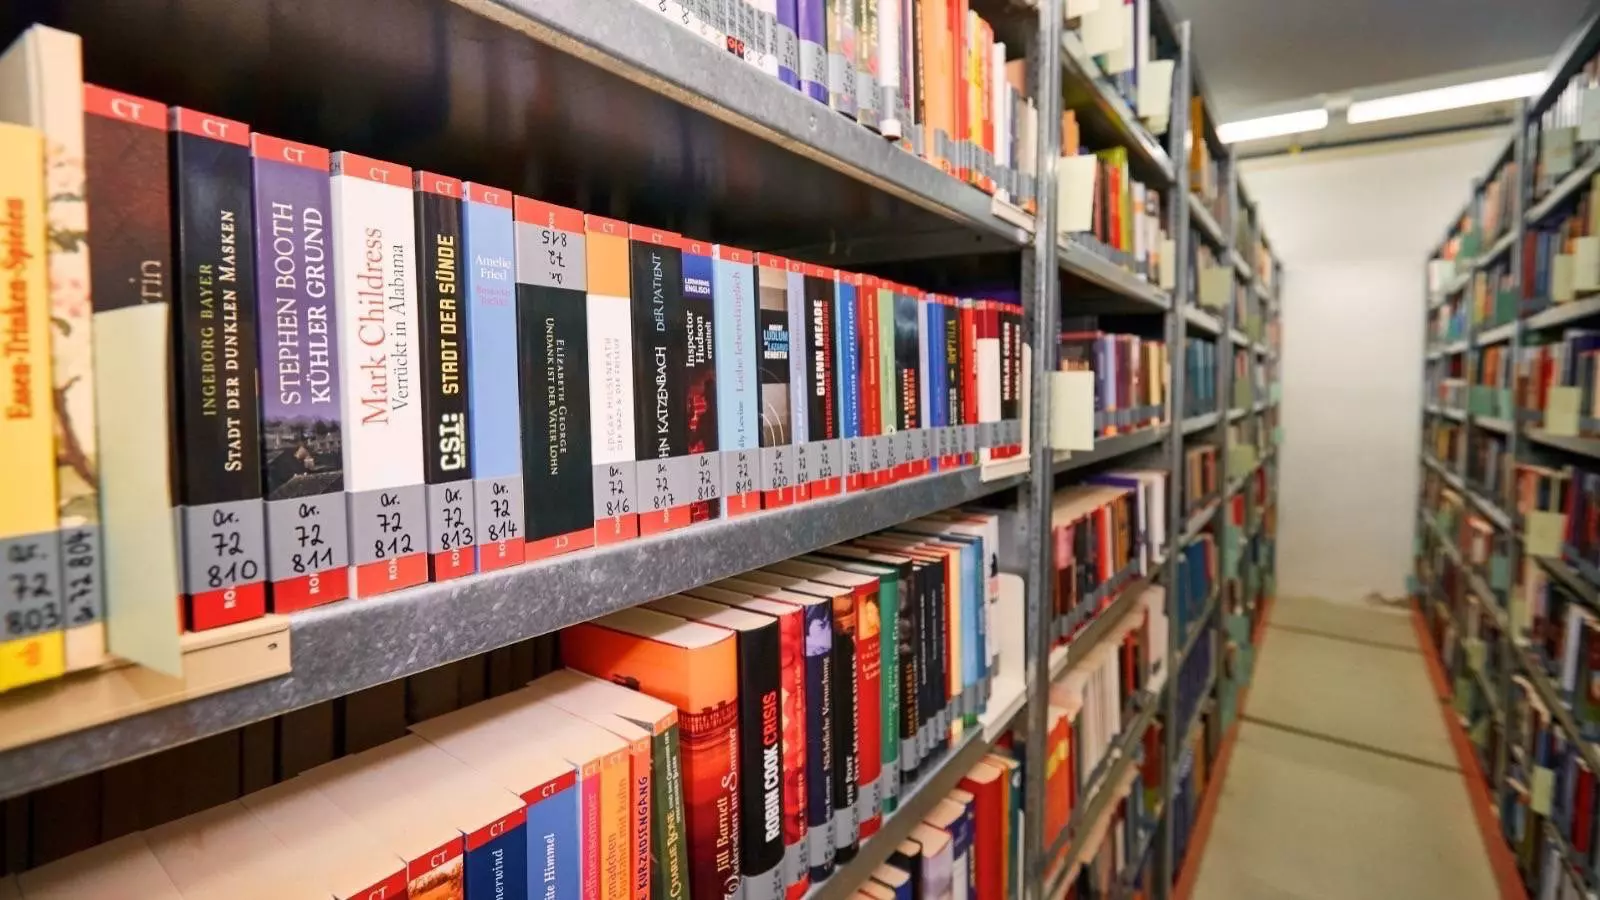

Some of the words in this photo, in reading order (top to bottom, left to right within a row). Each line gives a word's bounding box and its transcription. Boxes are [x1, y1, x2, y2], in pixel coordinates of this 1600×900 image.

[111, 98, 144, 121] CT
[202, 118, 229, 138] CT
[283, 146, 306, 163] CT
[369, 167, 390, 184] CT
[435, 181, 453, 195] CT
[484, 191, 500, 205] CT
[541, 230, 567, 248] 815
[602, 222, 615, 233] CT
[218, 209, 236, 282] MASKEN
[272, 202, 296, 290] BOOTH
[303, 207, 325, 299] GRUND
[547, 249, 567, 268] 72
[435, 234, 456, 294] SÜNDE
[652, 252, 665, 303] PATIENT
[199, 264, 213, 319] BAYER
[356, 227, 387, 346] Childress
[388, 245, 406, 317] Alabama
[222, 289, 240, 370] DUNKLEN
[391, 321, 407, 338] in
[439, 297, 458, 335] DER
[653, 304, 666, 332] DER
[813, 299, 824, 347] MEADE
[277, 298, 302, 404] STEPHEN
[545, 317, 555, 364] UNDANK
[686, 310, 695, 367] Inspector
[694, 316, 705, 363] Hudson
[307, 305, 331, 403] KÜHLER
[440, 340, 459, 394] STADT
[201, 326, 217, 416] INGEBORG
[390, 341, 409, 411] Verrückt
[547, 366, 555, 382] IST
[815, 350, 826, 397] GLENN
[225, 377, 240, 410] DER
[359, 353, 389, 426] Mark
[548, 385, 556, 407] DER
[654, 346, 669, 434] KATZENBACH
[224, 417, 242, 472] STADT
[439, 413, 461, 471] CSI:
[558, 405, 568, 454] GEORGE
[550, 445, 559, 475] LOHN
[658, 438, 671, 458] HN
[608, 480, 625, 495] 72
[655, 480, 669, 493] 72
[698, 471, 711, 484] 72
[490, 499, 511, 518] 72
[606, 499, 630, 516] 816
[653, 493, 675, 508] 817
[376, 512, 403, 533] 72
[443, 507, 465, 528] 72
[488, 522, 517, 542] 814
[211, 531, 244, 558] 72
[294, 524, 325, 547] 72
[375, 534, 415, 559] 812
[441, 528, 474, 551] 813
[207, 559, 259, 588] 810
[291, 548, 334, 573] 811
[8, 572, 53, 602] 72
[5, 602, 62, 635] 803
[761, 690, 778, 746] CRISIS
[721, 727, 738, 792] Sommer
[762, 743, 779, 793] COOK
[541, 783, 557, 798] CT
[729, 792, 739, 812] im
[490, 819, 507, 837] CT
[667, 805, 679, 846] BONE
[716, 797, 729, 849] Barnett
[763, 792, 781, 843] ROBIN
[636, 776, 649, 891] KURZHOSENGANG
[430, 849, 448, 868] CT
[543, 832, 555, 881] Himmel
[670, 843, 683, 898] CHARLIE
[717, 848, 730, 872] Jill
[369, 885, 389, 900] CT
